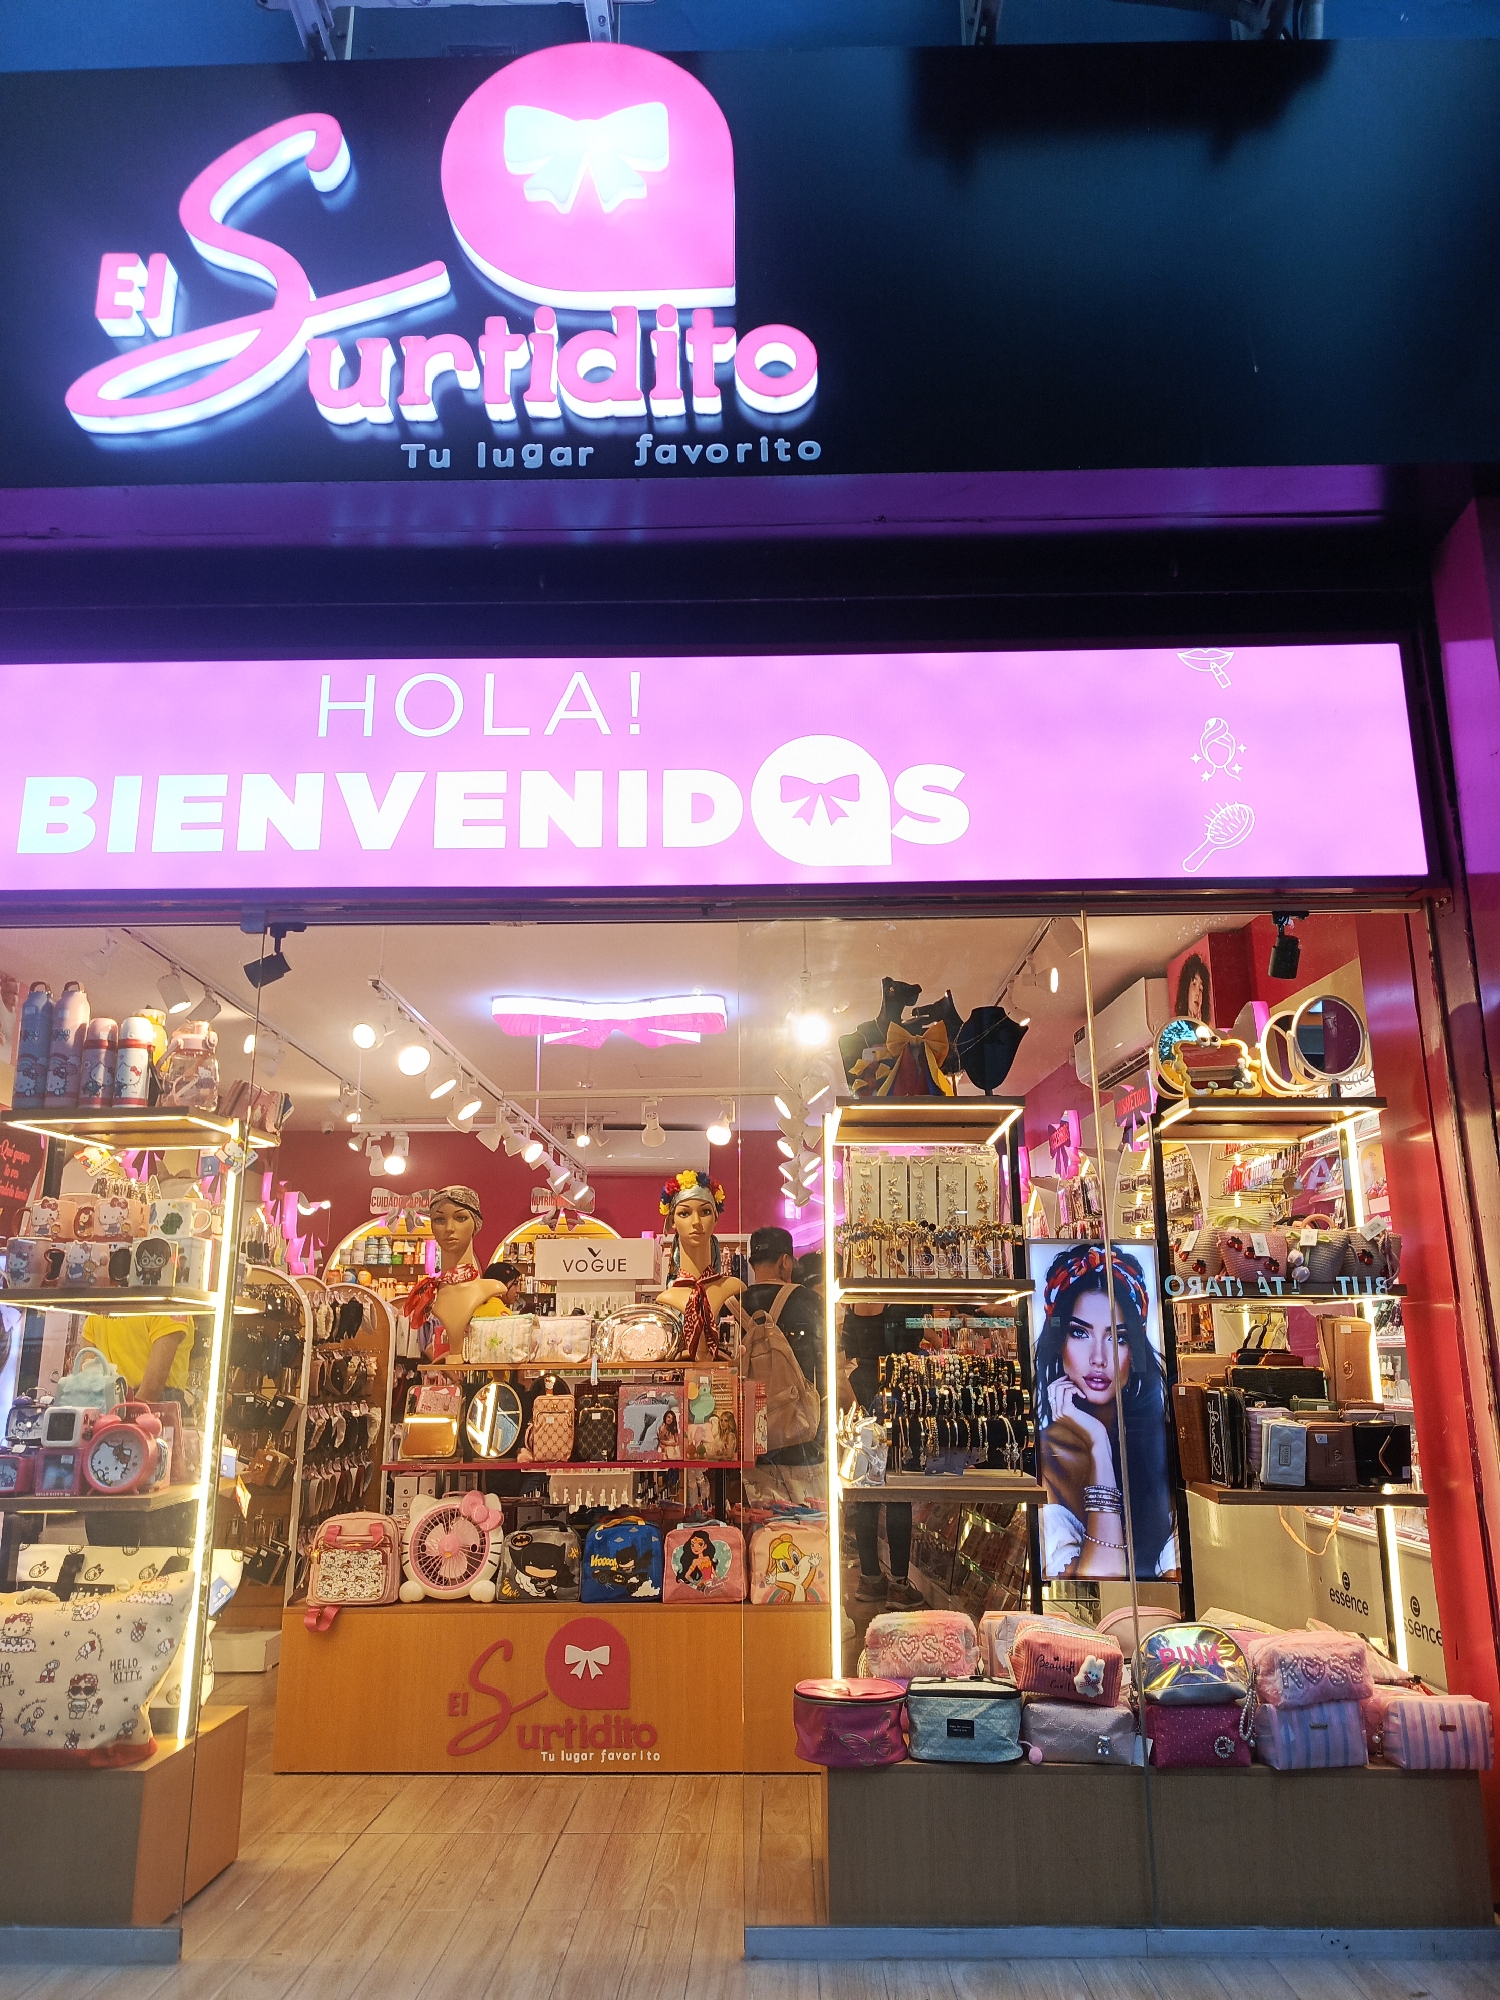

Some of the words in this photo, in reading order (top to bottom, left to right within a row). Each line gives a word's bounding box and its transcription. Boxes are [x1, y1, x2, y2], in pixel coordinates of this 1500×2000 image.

[65, 112, 818, 432] Surtidito
[95, 253, 175, 335] El
[401, 443, 451, 469] Tu
[477, 442, 594, 469] lugar
[634, 434, 822, 466] favorito
[318, 671, 642, 737] HOLA!
[405, 1196, 431, 1208] CAPILA
[562, 1258, 627, 1273] VOGUE
[1329, 1588, 1369, 1616] essence
[109, 1658, 139, 1671] HELLO
[1158, 1642, 1223, 1671] PINK
[113, 1671, 141, 1684] KITTY
[446, 1638, 658, 1756] Surtidito
[448, 1691, 469, 1716] El
[540, 1751, 555, 1762] Tu
[560, 1749, 594, 1763] lugar
[600, 1748, 661, 1763] favorito
